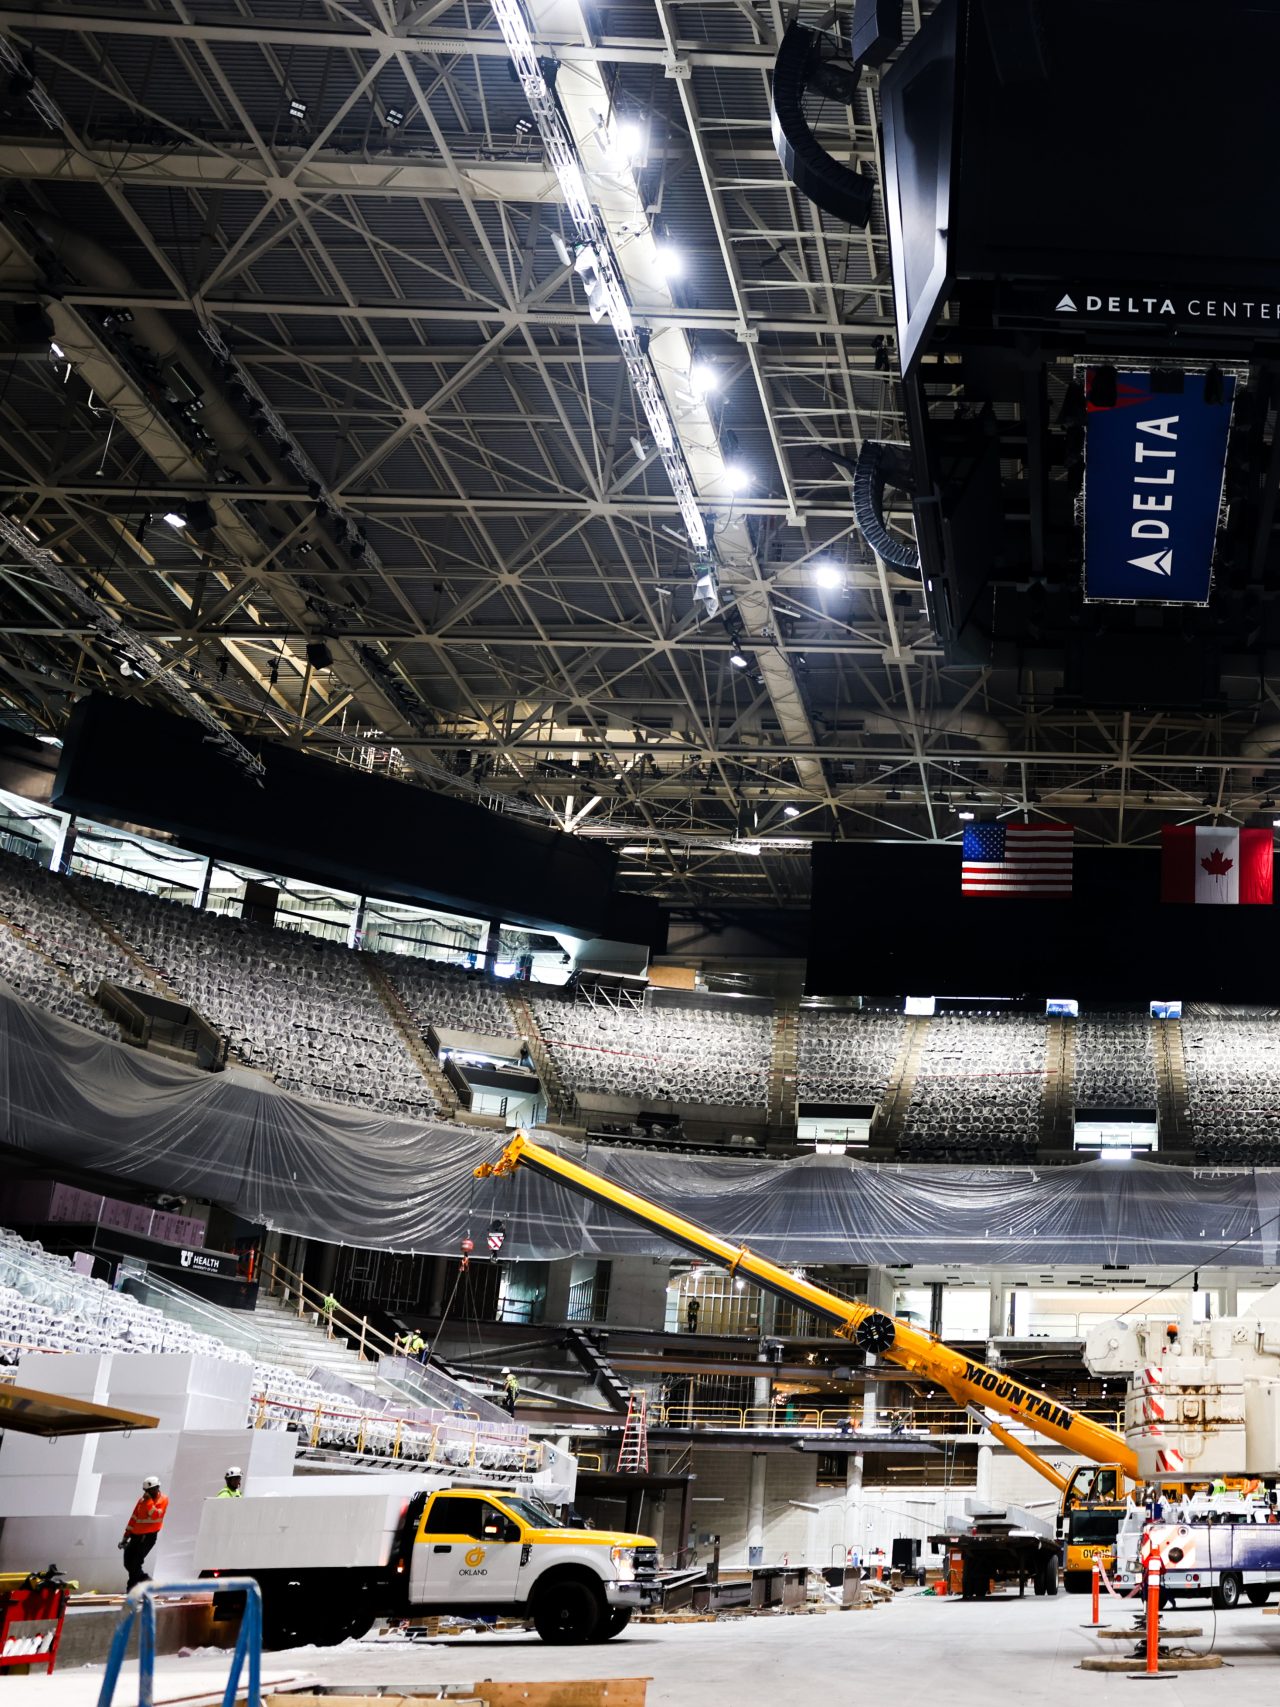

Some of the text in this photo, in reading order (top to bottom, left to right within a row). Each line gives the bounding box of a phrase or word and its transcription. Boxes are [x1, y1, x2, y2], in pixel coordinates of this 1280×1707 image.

[1086, 295, 1176, 315] DELTA
[1131, 415, 1180, 539] DELTA
[193, 1255, 220, 1268] HEALTH
[962, 1361, 1074, 1431] MOUNTAIN
[1162, 1489, 1177, 1500] M
